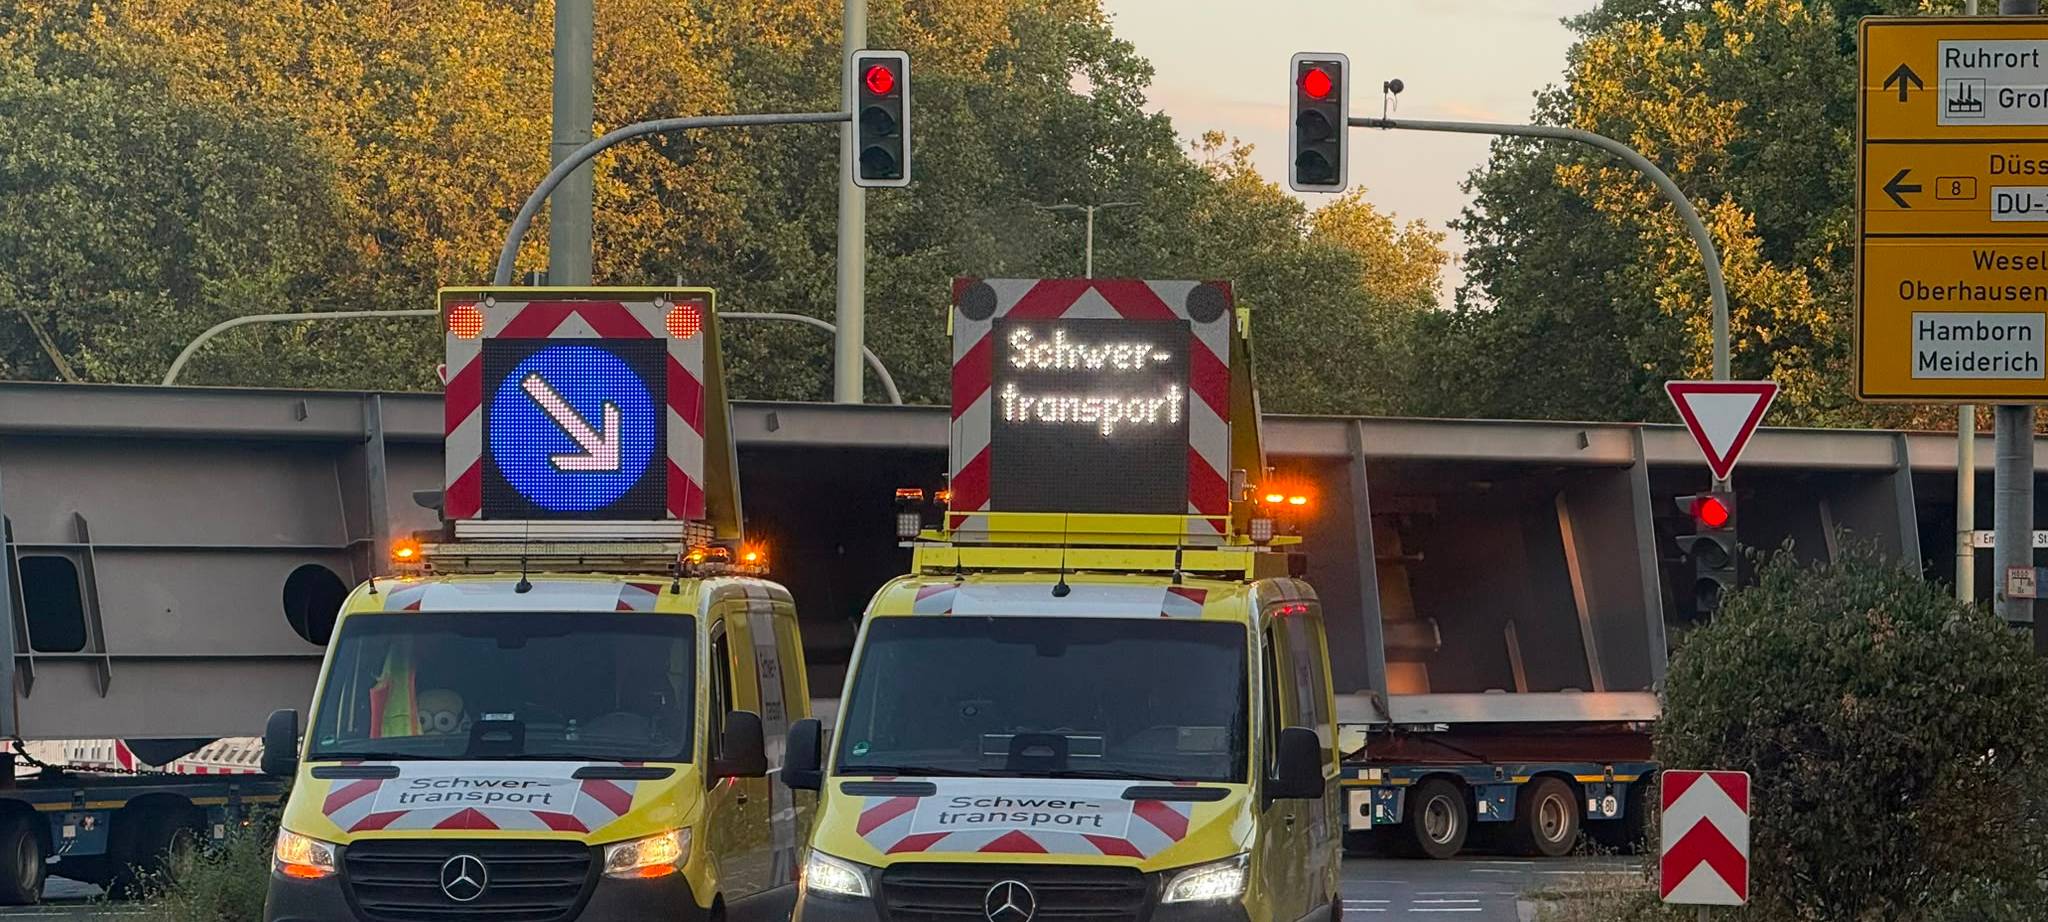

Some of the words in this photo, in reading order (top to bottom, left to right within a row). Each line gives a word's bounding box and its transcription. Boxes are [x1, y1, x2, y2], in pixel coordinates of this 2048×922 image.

[1945, 47, 2039, 68] Ruhrort
[1951, 181, 1961, 196] 8
[1998, 193, 2048, 214] DU-
[1973, 250, 2048, 271] Wesel
[1899, 280, 2048, 301] Oberhausen
[1919, 320, 2032, 341] Hamborn
[1010, 328, 1171, 369] Schwer-
[1919, 351, 2039, 372] Meiderich
[1001, 384, 1183, 437] transport
[410, 778, 552, 790] Schwer-
[400, 791, 552, 805] transport
[949, 796, 1100, 809] Schwer-
[939, 811, 1103, 828] transport
